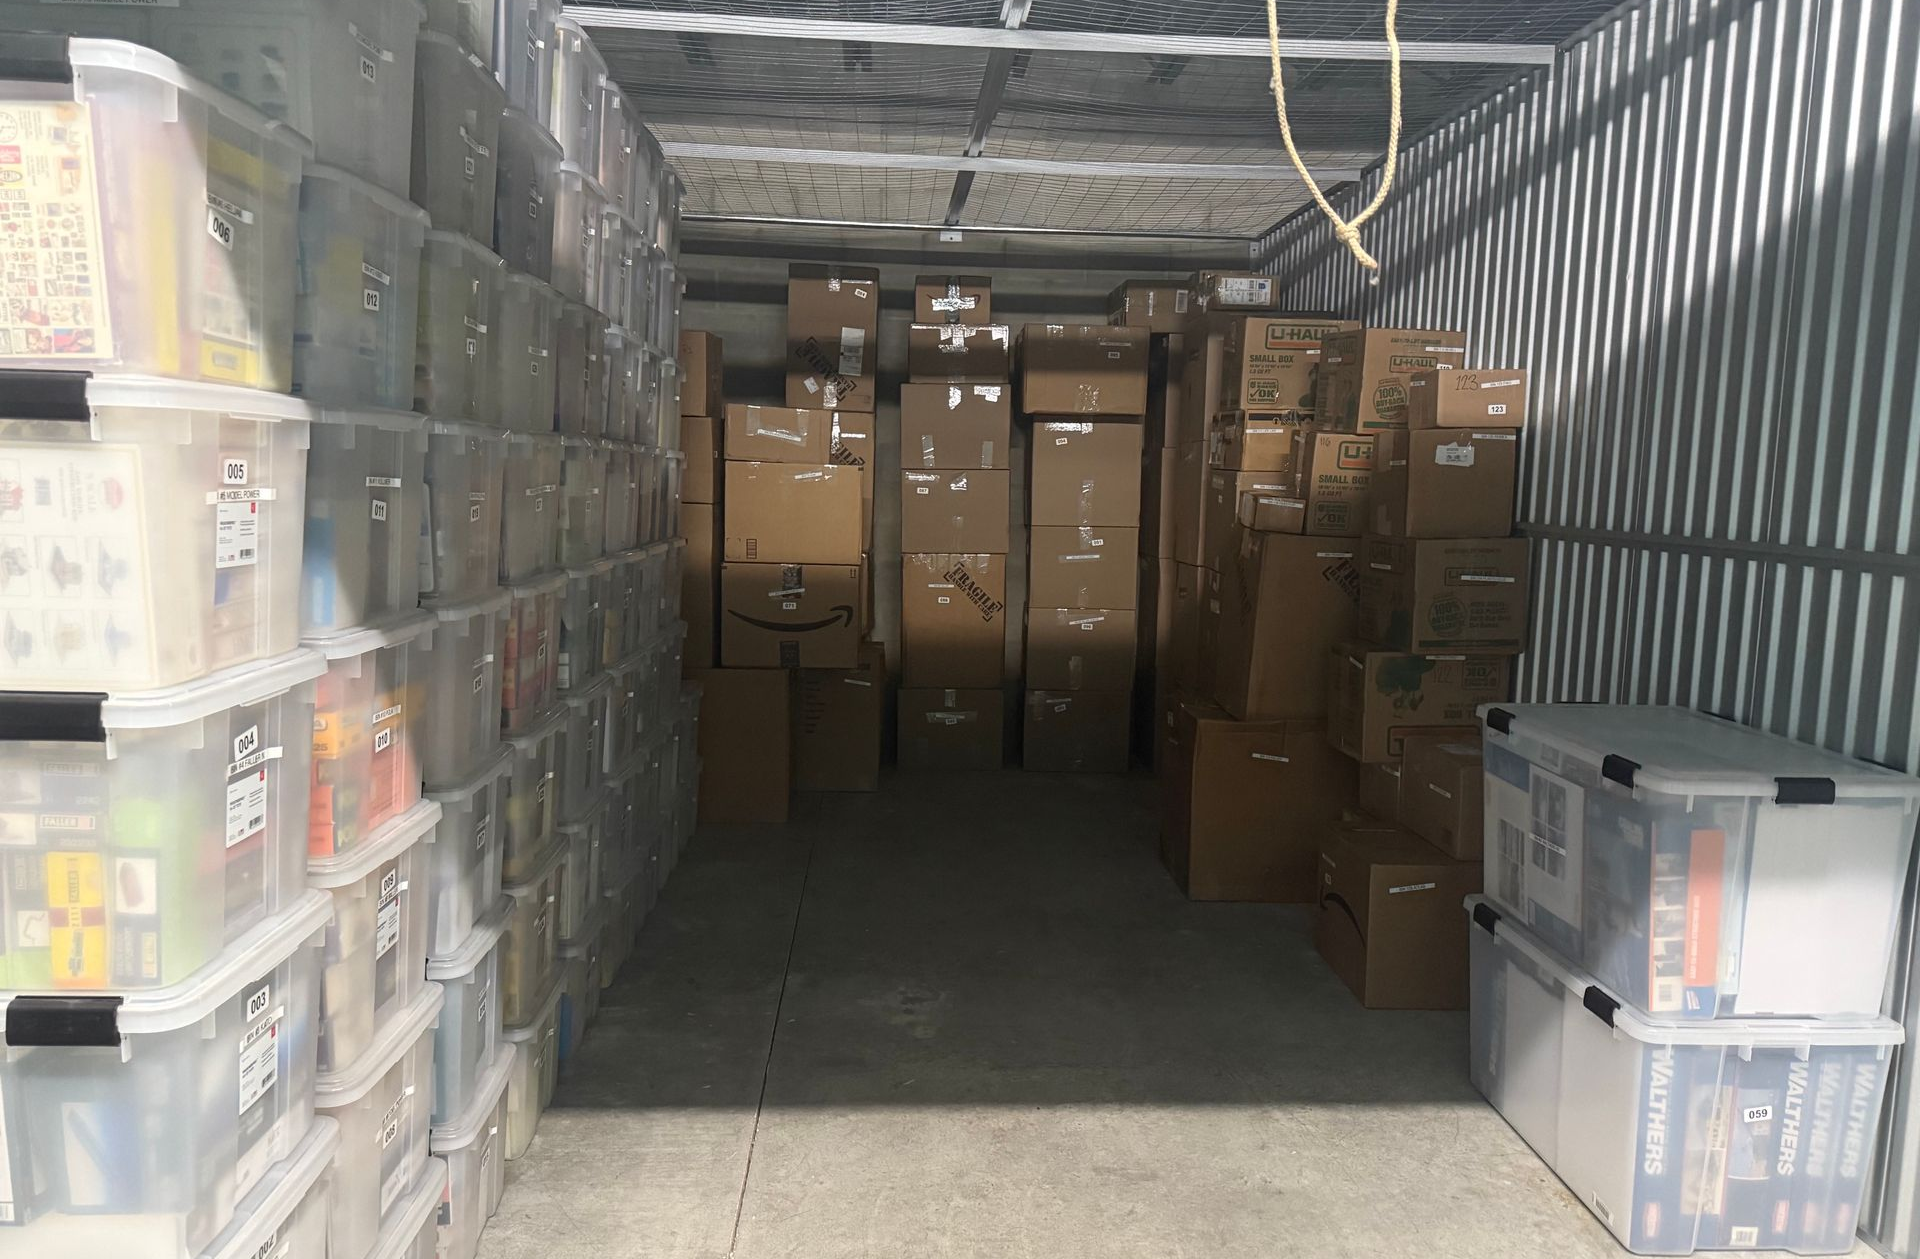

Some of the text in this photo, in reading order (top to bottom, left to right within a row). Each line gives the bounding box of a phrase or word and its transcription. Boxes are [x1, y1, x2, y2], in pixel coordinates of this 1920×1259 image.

[362, 60, 374, 79] 013
[213, 217, 230, 243] 006
[367, 292, 378, 307] 012
[1249, 354, 1295, 364] SMALL BOX
[1393, 358, 1434, 367] U-HAUL
[1456, 374, 1479, 391] 123
[1259, 389, 1275, 398] OK
[1379, 386, 1403, 399] 100%
[227, 463, 244, 480] 005
[1318, 474, 1370, 485] SMALL BOX
[226, 490, 243, 500] MODEL
[243, 489, 260, 499] POWER
[375, 503, 384, 518] 011
[948, 573, 992, 618] HANDLE WITH CARE
[951, 566, 998, 614] FRAGILE
[238, 731, 255, 754] 004
[377, 732, 388, 748] 010
[244, 753, 261, 768] FALLER
[250, 991, 266, 1015] 003
[1644, 1049, 1675, 1176] WALTHERS
[1748, 1108, 1768, 1120] 059
[1777, 1060, 1809, 1177] WALTHERS
[1806, 1063, 1842, 1179] WALTHERS
[1839, 1063, 1877, 1179] WALTHERS
[385, 1123, 396, 1143] 008
